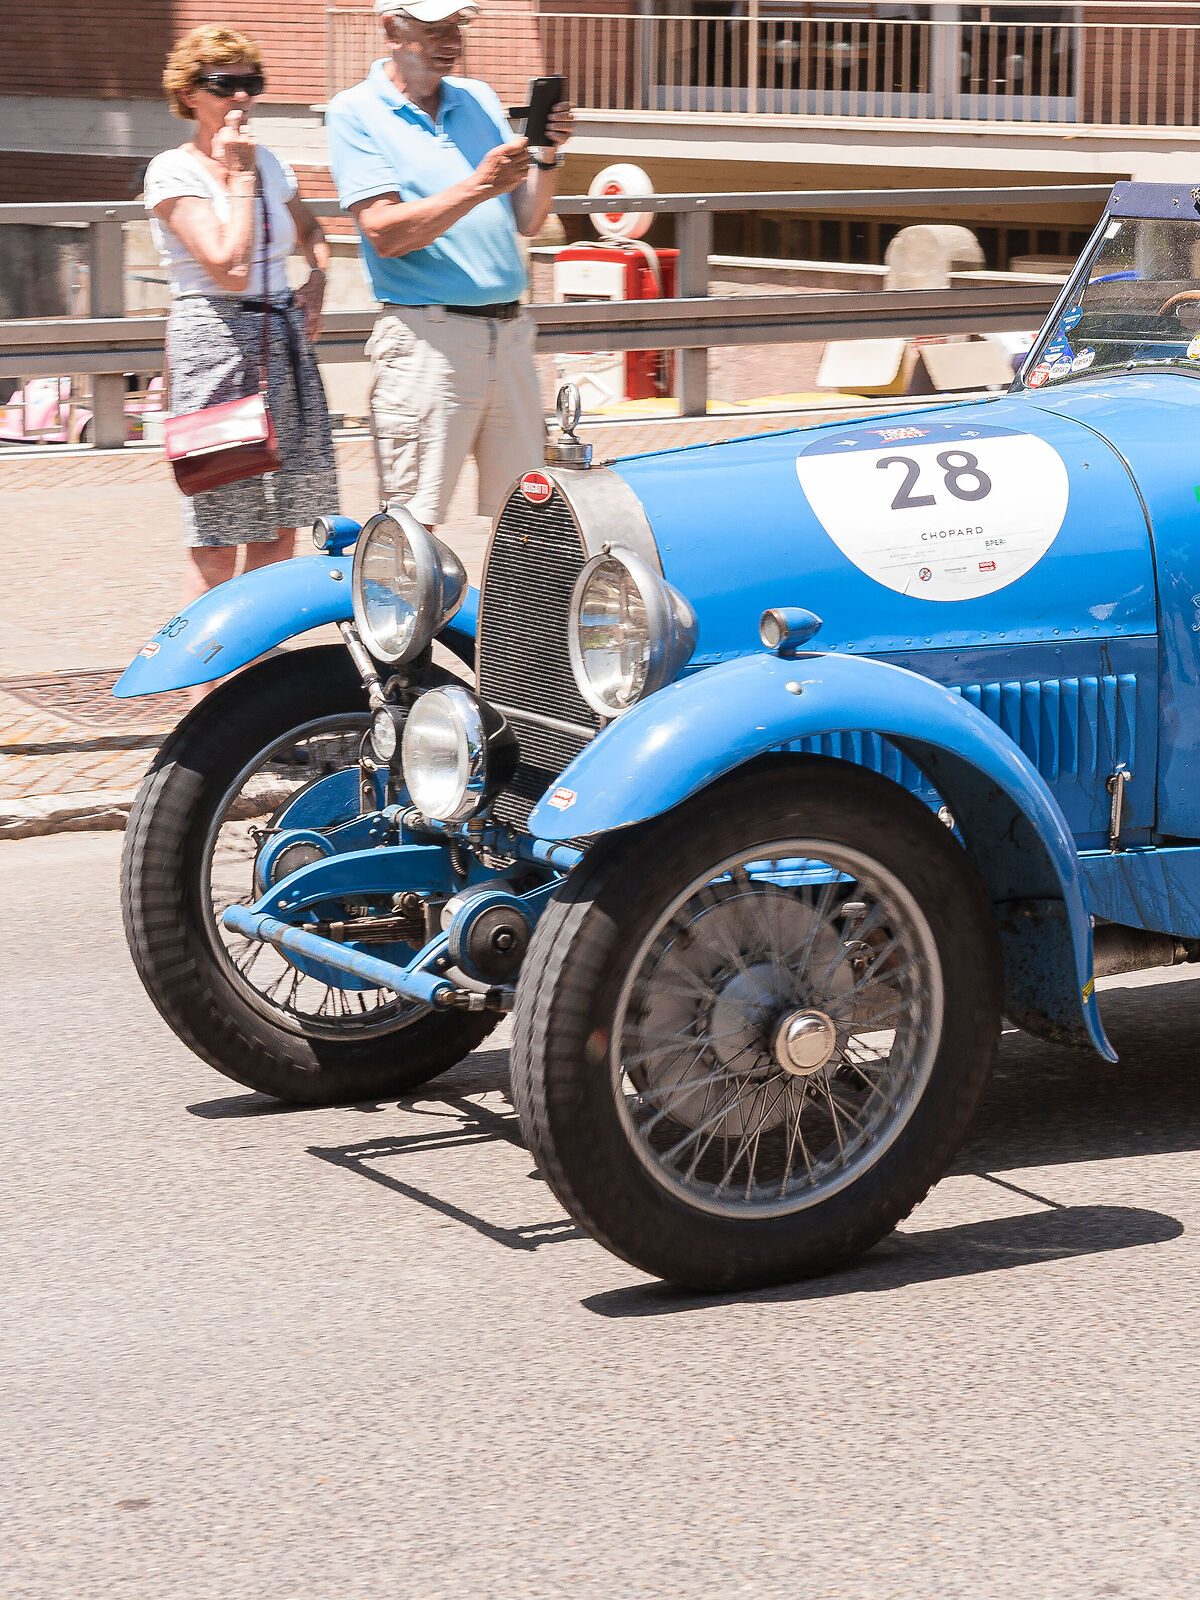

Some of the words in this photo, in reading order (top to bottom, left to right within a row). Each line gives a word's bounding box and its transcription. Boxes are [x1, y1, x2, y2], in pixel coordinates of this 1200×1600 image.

[876, 450, 991, 509] 28
[921, 526, 983, 541] CHOPARD
[157, 615, 189, 638] 93
